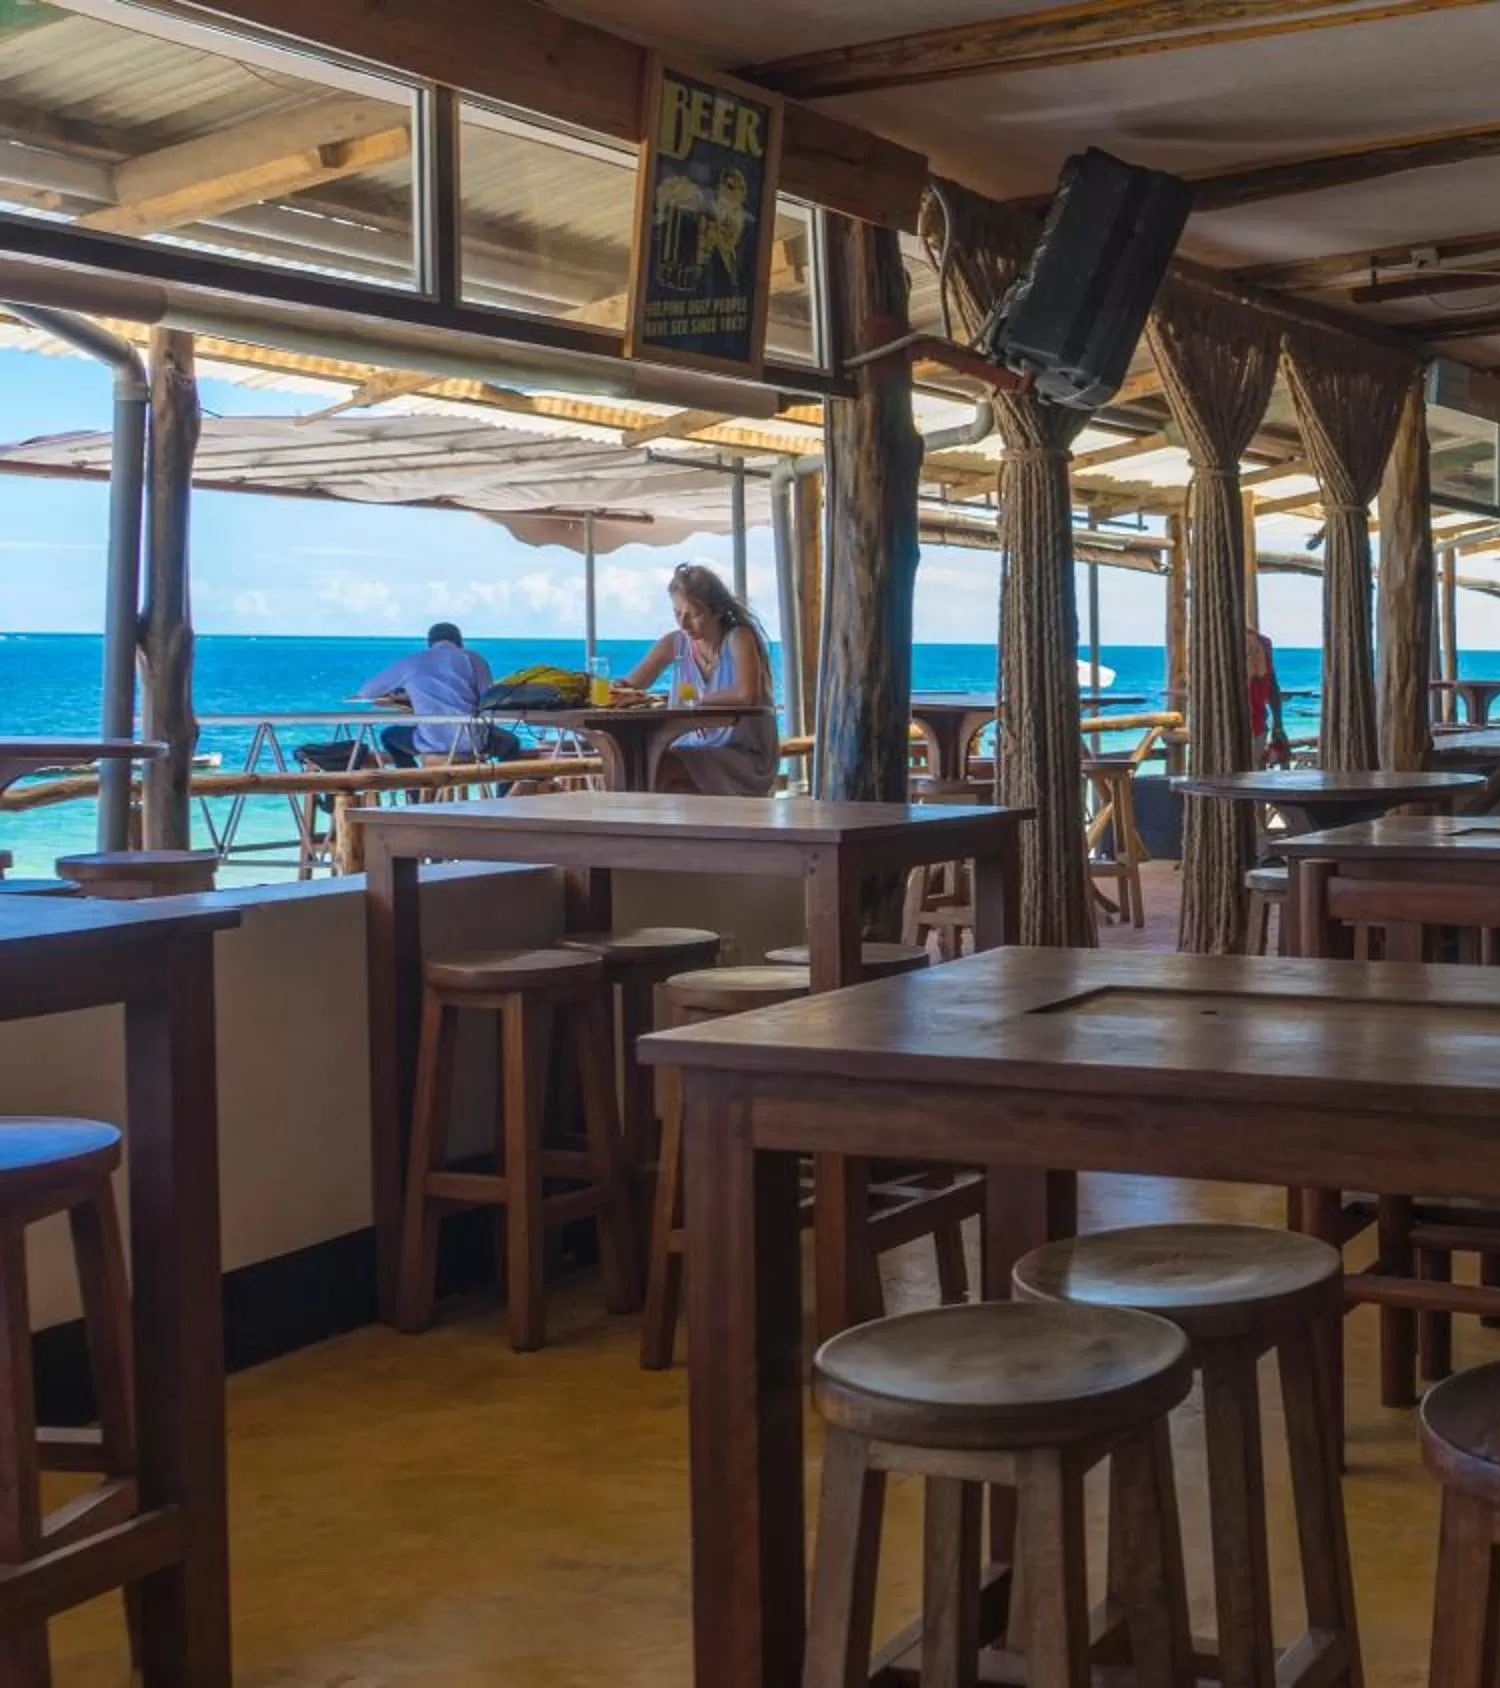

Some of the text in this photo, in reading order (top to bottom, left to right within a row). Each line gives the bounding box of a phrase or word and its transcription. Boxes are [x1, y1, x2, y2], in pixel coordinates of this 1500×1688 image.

[657, 80, 763, 160] BEER
[713, 297, 747, 313] PEOPLE
[671, 319, 689, 335] SEX
[690, 317, 717, 333] SINCE
